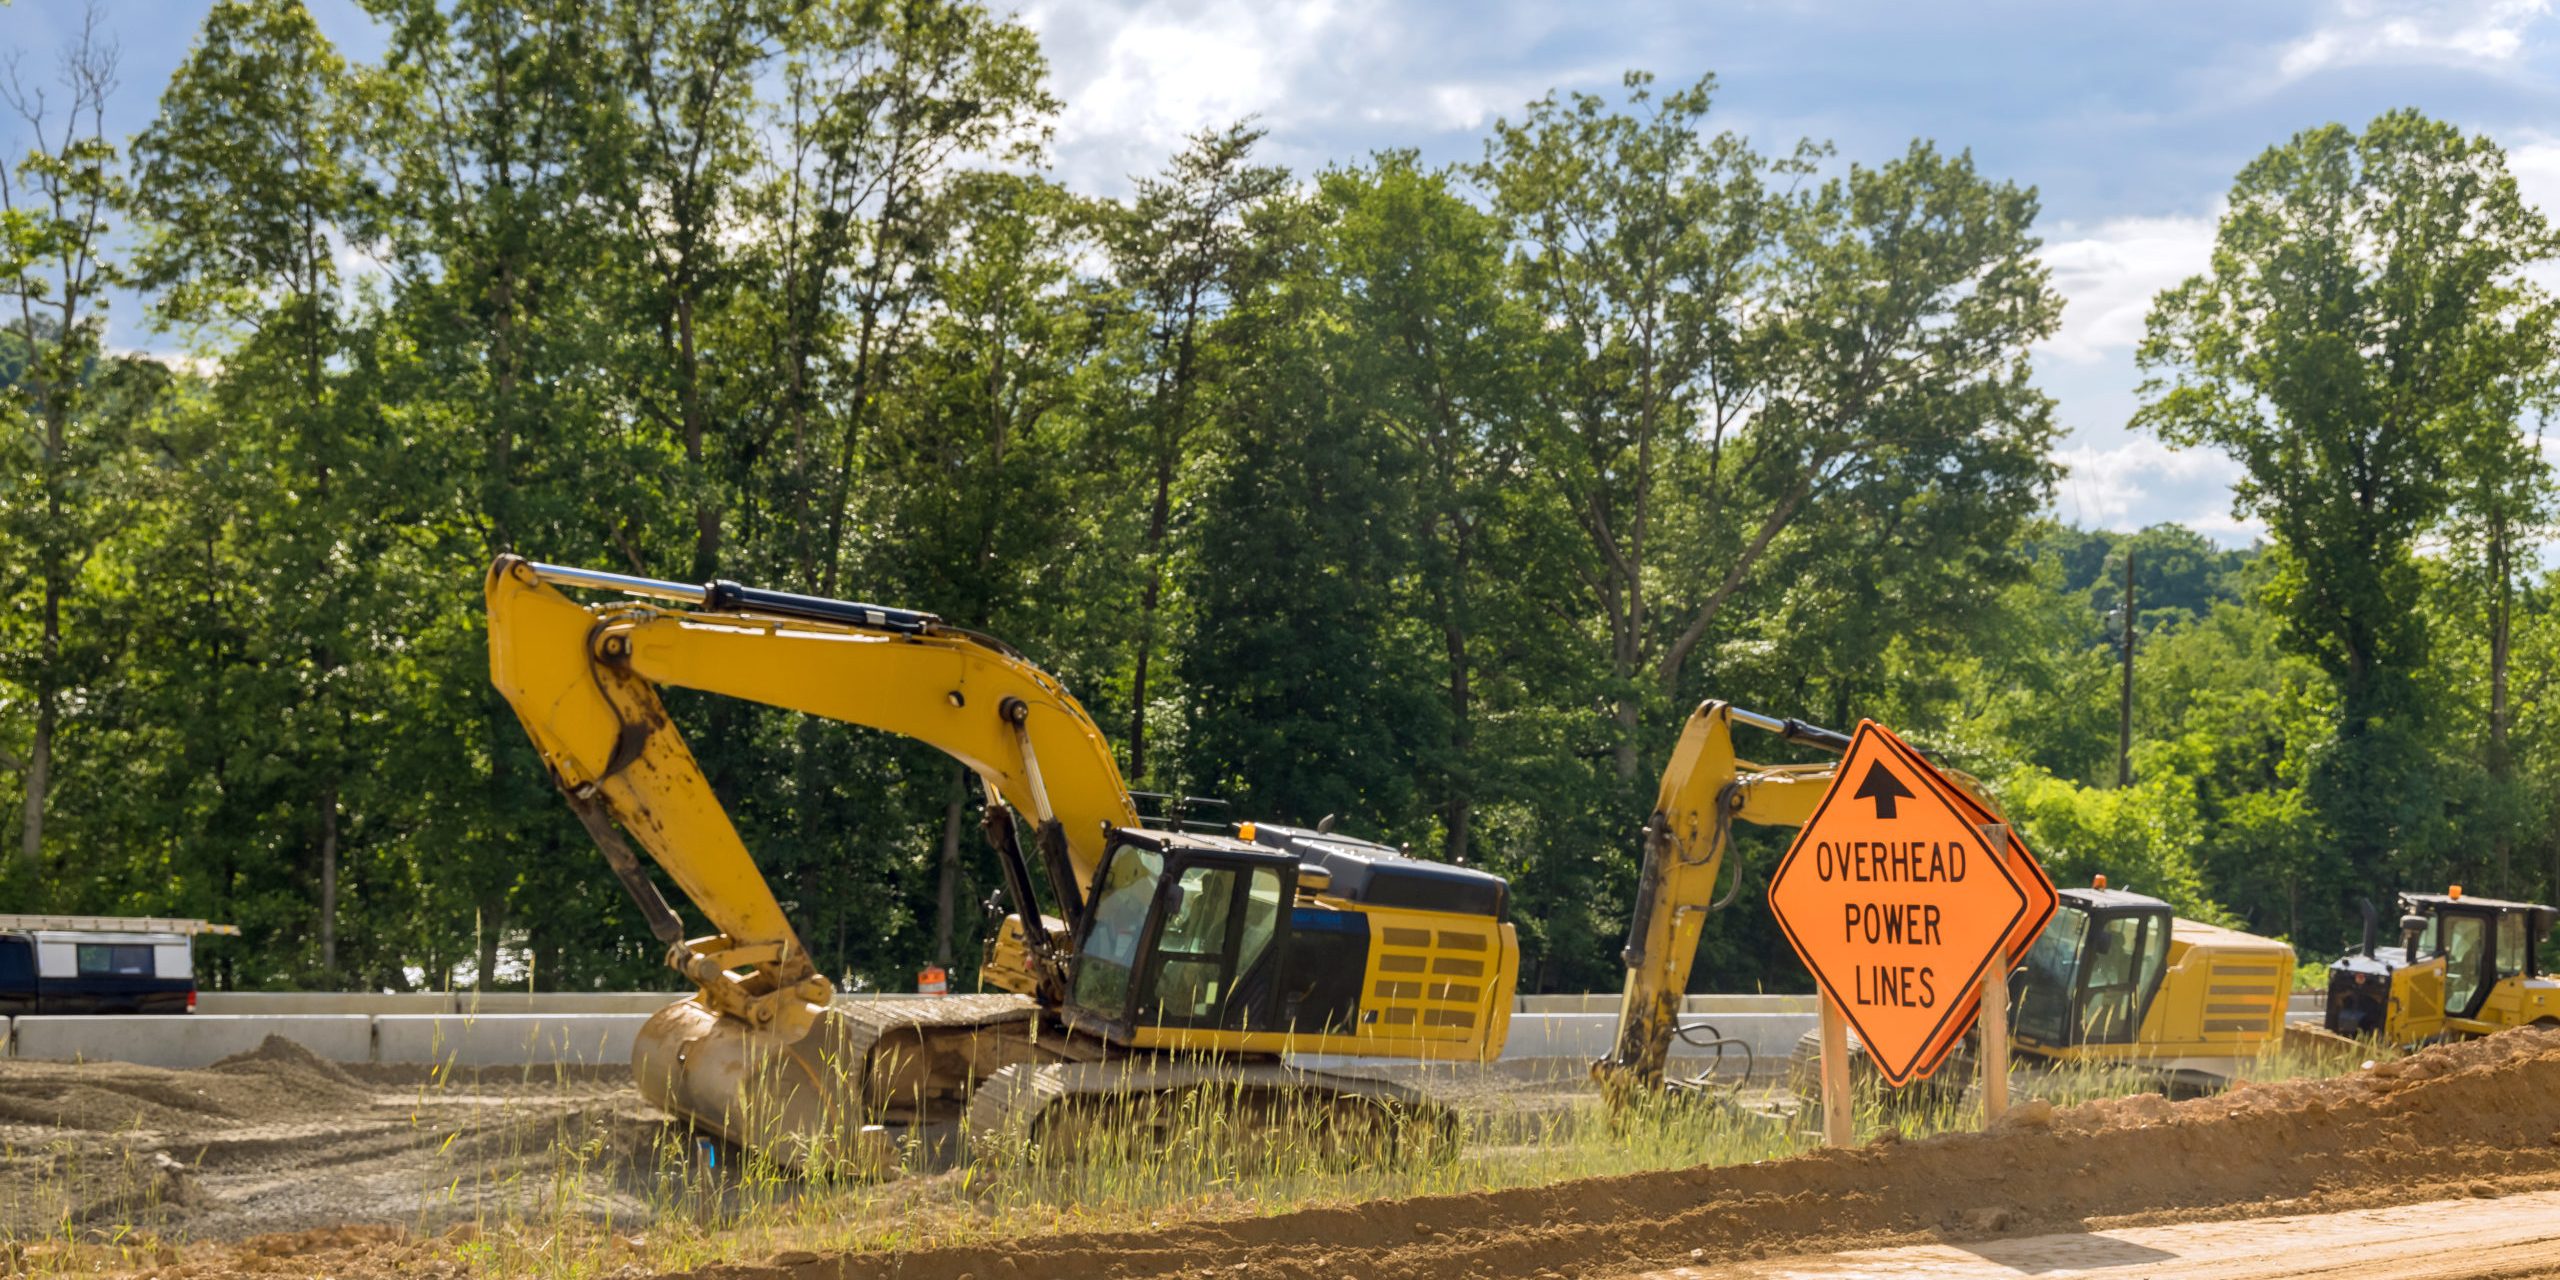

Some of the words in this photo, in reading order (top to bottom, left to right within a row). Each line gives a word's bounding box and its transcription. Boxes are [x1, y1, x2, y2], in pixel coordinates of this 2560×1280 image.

[1816, 841, 1966, 883] OVERHEAD
[1845, 903, 1941, 945] POWER
[1856, 965, 1935, 1008] LINES
